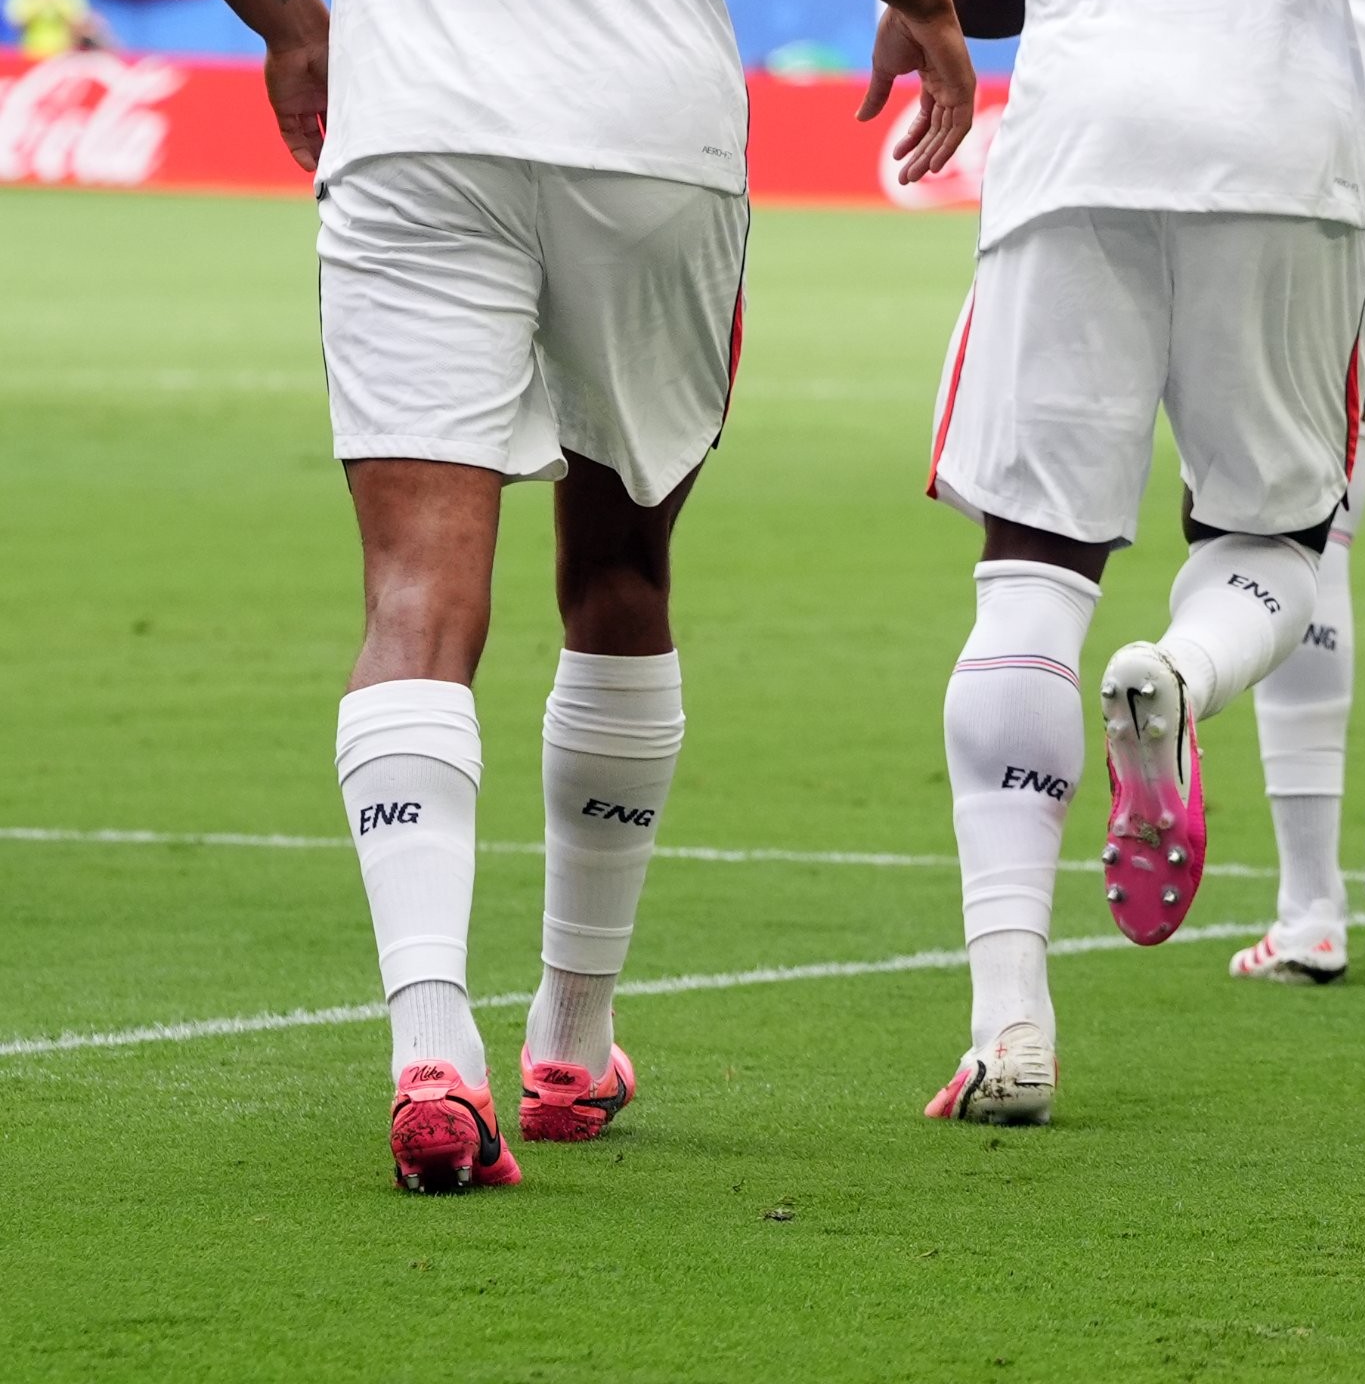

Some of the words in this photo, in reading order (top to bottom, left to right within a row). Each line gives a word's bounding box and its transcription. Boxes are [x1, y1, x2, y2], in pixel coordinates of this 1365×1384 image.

[1227, 573, 1281, 614] ENG
[1303, 622, 1339, 652] NG
[1002, 766, 1069, 801] ENG
[360, 802, 421, 836] ENG
[582, 798, 655, 827] ENG
[409, 1065, 445, 1084] Nike
[543, 1067, 576, 1085] Nike
